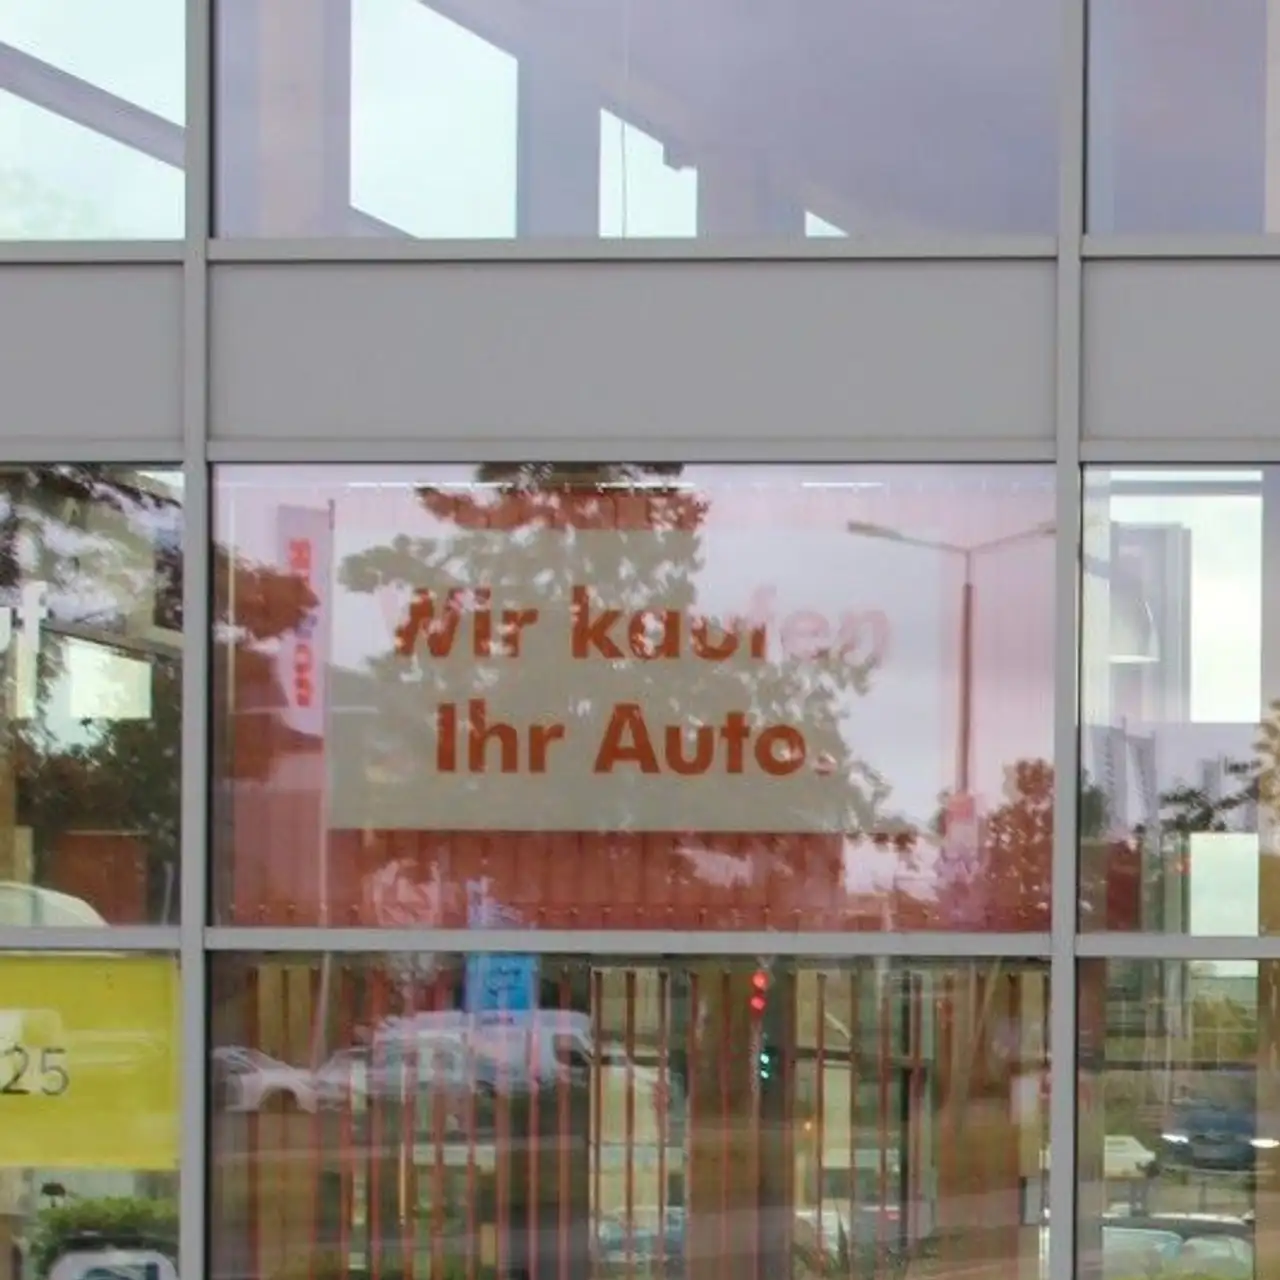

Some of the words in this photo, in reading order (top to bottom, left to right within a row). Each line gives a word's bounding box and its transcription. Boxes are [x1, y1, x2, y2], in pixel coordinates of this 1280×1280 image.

[384, 586, 538, 660] Wir
[571, 583, 892, 664] kaufen
[436, 699, 565, 774] Ihr
